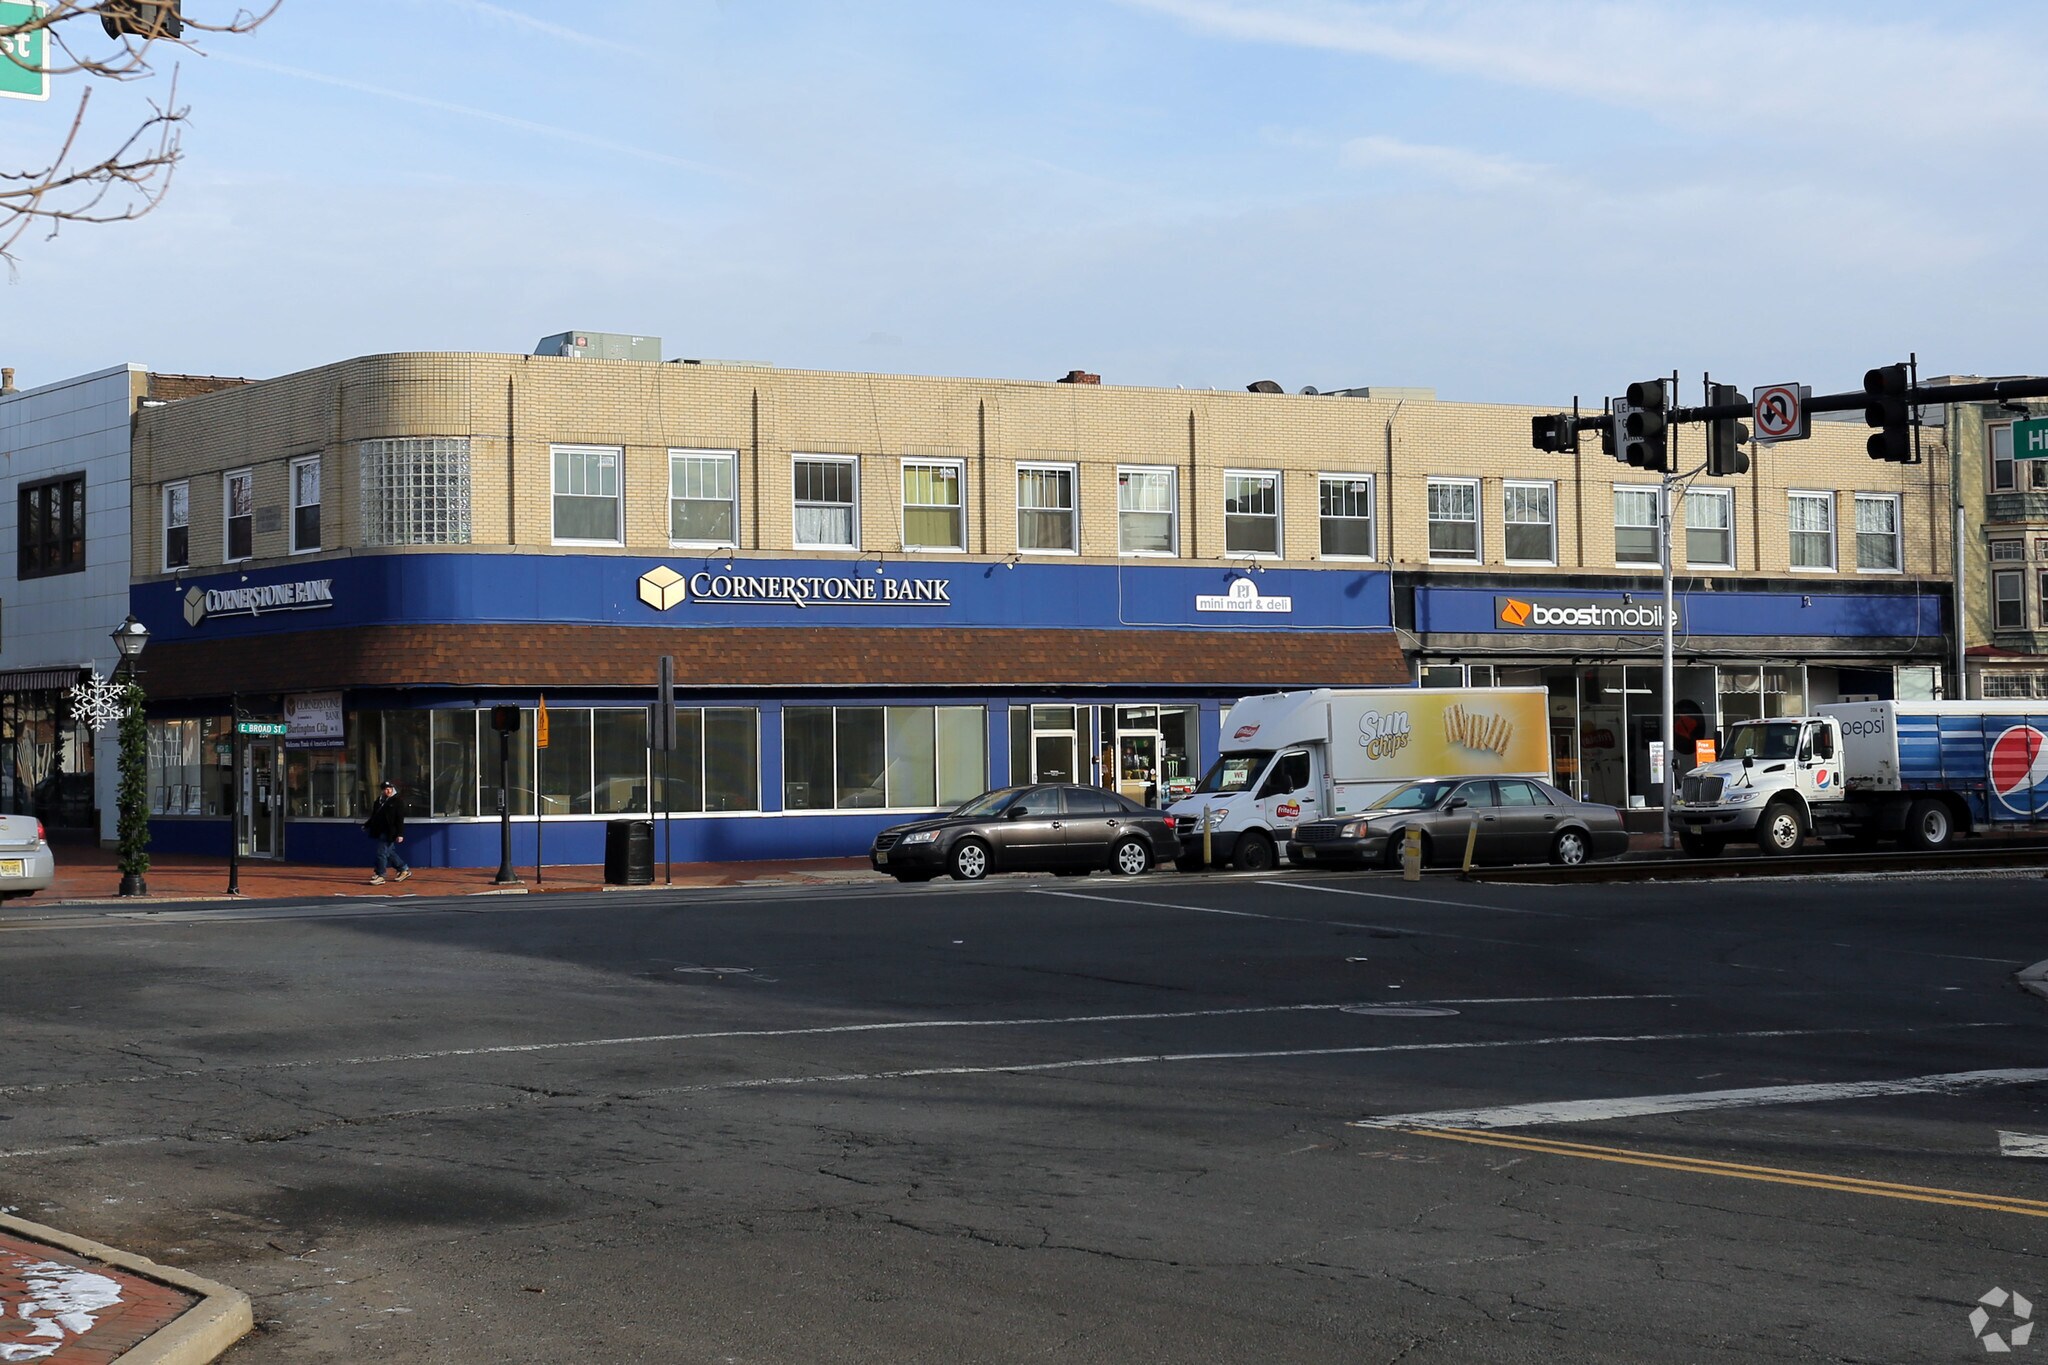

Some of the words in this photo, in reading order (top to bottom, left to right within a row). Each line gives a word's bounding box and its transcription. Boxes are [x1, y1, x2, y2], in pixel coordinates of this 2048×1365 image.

[205, 583, 295, 617] CORNERSTONE
[295, 579, 333, 603] BANK
[690, 572, 877, 608] CORNERSTONE
[883, 578, 950, 600] BANK
[1237, 585, 1250, 598] PJ
[1200, 598, 1224, 609] mini
[1227, 599, 1252, 609] mart
[1256, 600, 1263, 610] &
[1267, 599, 1287, 610] deli
[325, 711, 341, 721] BANK
[1842, 716, 1885, 739] pepsi
[248, 725, 272, 733] BROAD
[1359, 710, 1411, 747] Sun
[1367, 733, 1408, 760] Chips
